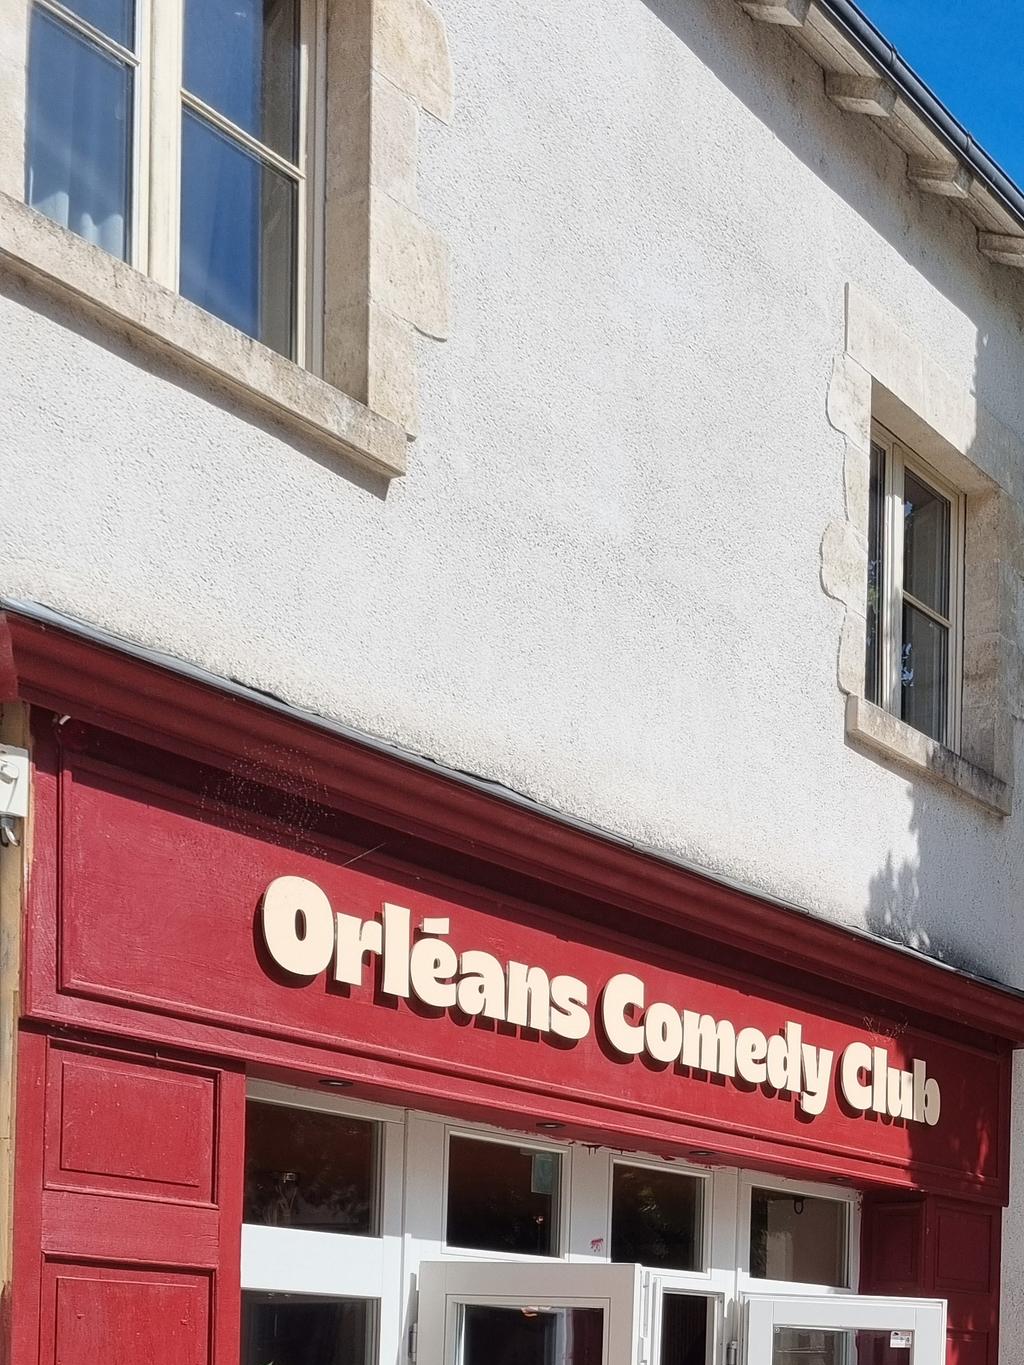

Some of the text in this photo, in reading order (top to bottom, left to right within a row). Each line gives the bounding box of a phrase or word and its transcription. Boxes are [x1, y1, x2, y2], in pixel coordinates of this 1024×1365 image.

[263, 875, 941, 1126] Orléans Comedy Club
